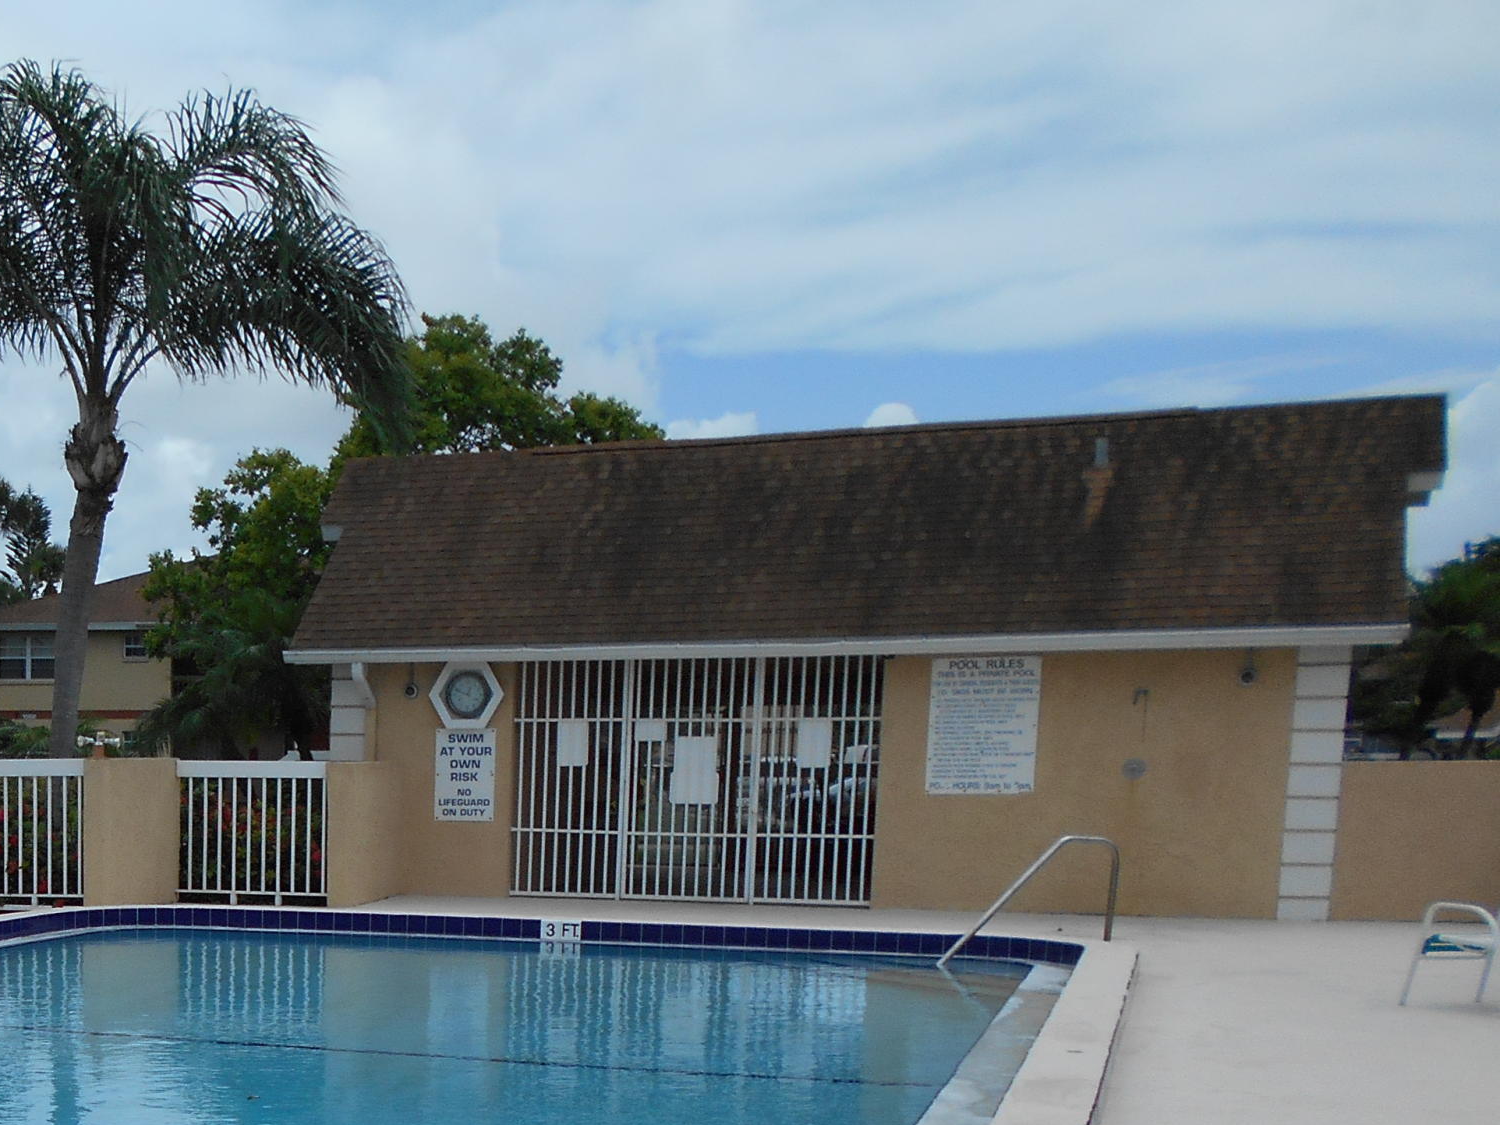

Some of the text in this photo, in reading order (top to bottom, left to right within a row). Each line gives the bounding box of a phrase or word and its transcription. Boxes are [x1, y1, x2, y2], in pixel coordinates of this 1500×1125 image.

[949, 659, 1024, 670] POOL RULES
[448, 734, 484, 743] SWIM
[440, 747, 492, 756] AT YOUR
[450, 760, 481, 769] OWN
[450, 772, 478, 782] RISK
[457, 788, 472, 796] NO
[546, 923, 580, 938] 3 FT.
